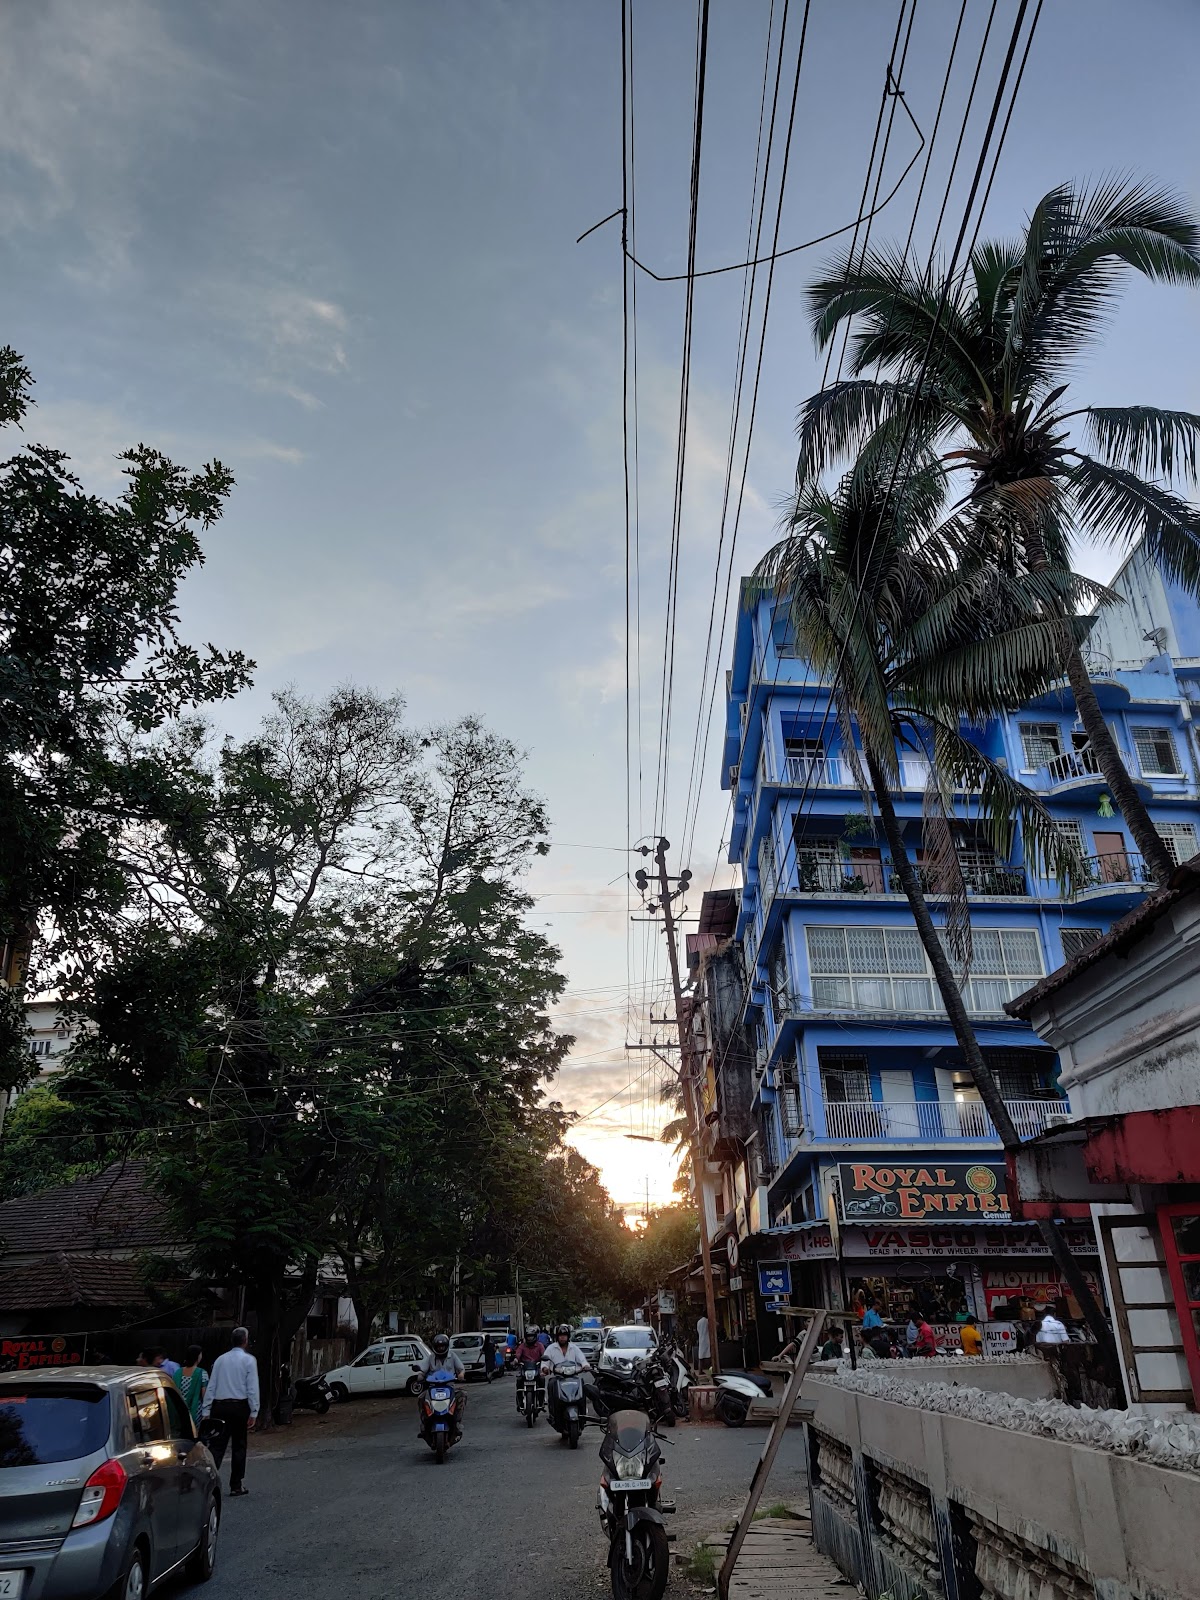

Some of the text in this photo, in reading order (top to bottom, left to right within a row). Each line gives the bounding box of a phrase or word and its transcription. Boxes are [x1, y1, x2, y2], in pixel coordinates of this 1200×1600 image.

[850, 1165, 956, 1194] ROYAL
[862, 1230, 1098, 1248] VASCO SPAES
[947, 1247, 978, 1255] WHEELER
[1, 1340, 47, 1358] ROYAL
[17, 1352, 81, 1370] ENFIELD
